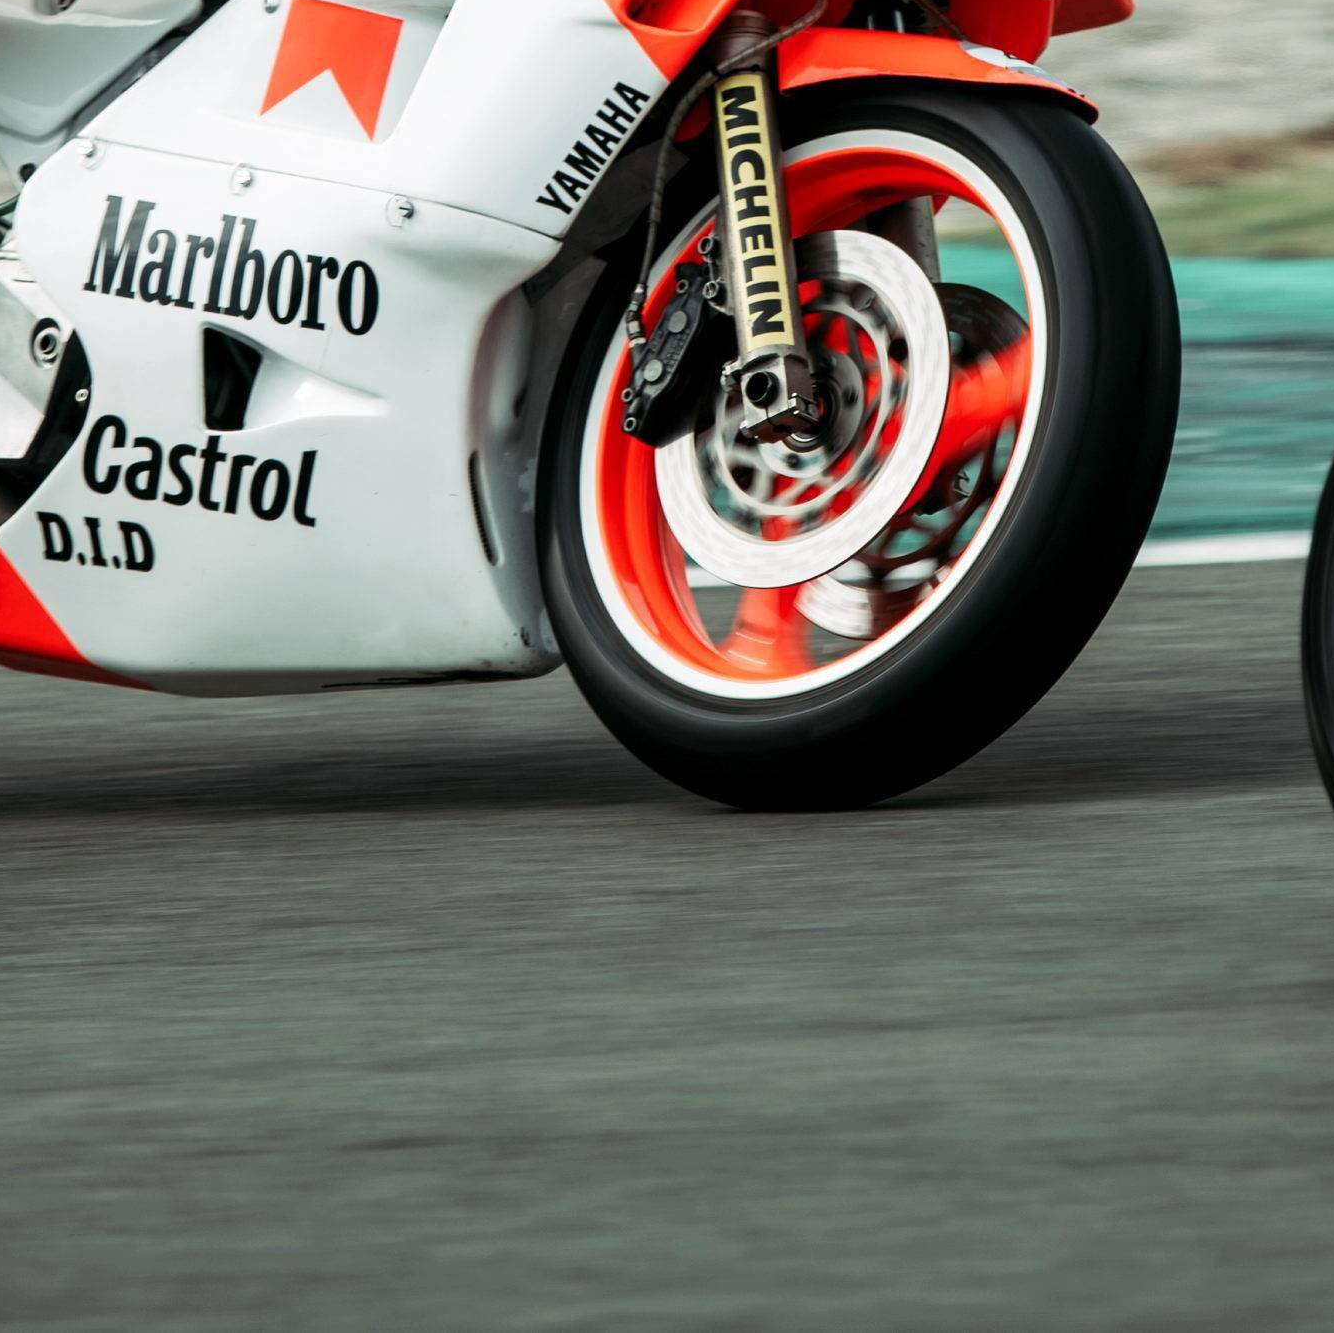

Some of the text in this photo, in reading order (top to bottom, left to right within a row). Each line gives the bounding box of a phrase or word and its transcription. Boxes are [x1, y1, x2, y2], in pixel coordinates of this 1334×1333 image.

[535, 80, 651, 216] YAMAHA
[721, 84, 785, 339] MICHELIN
[82, 195, 380, 337] Marlboro
[83, 413, 318, 528] Castrol
[35, 511, 156, 573] D.I.D
